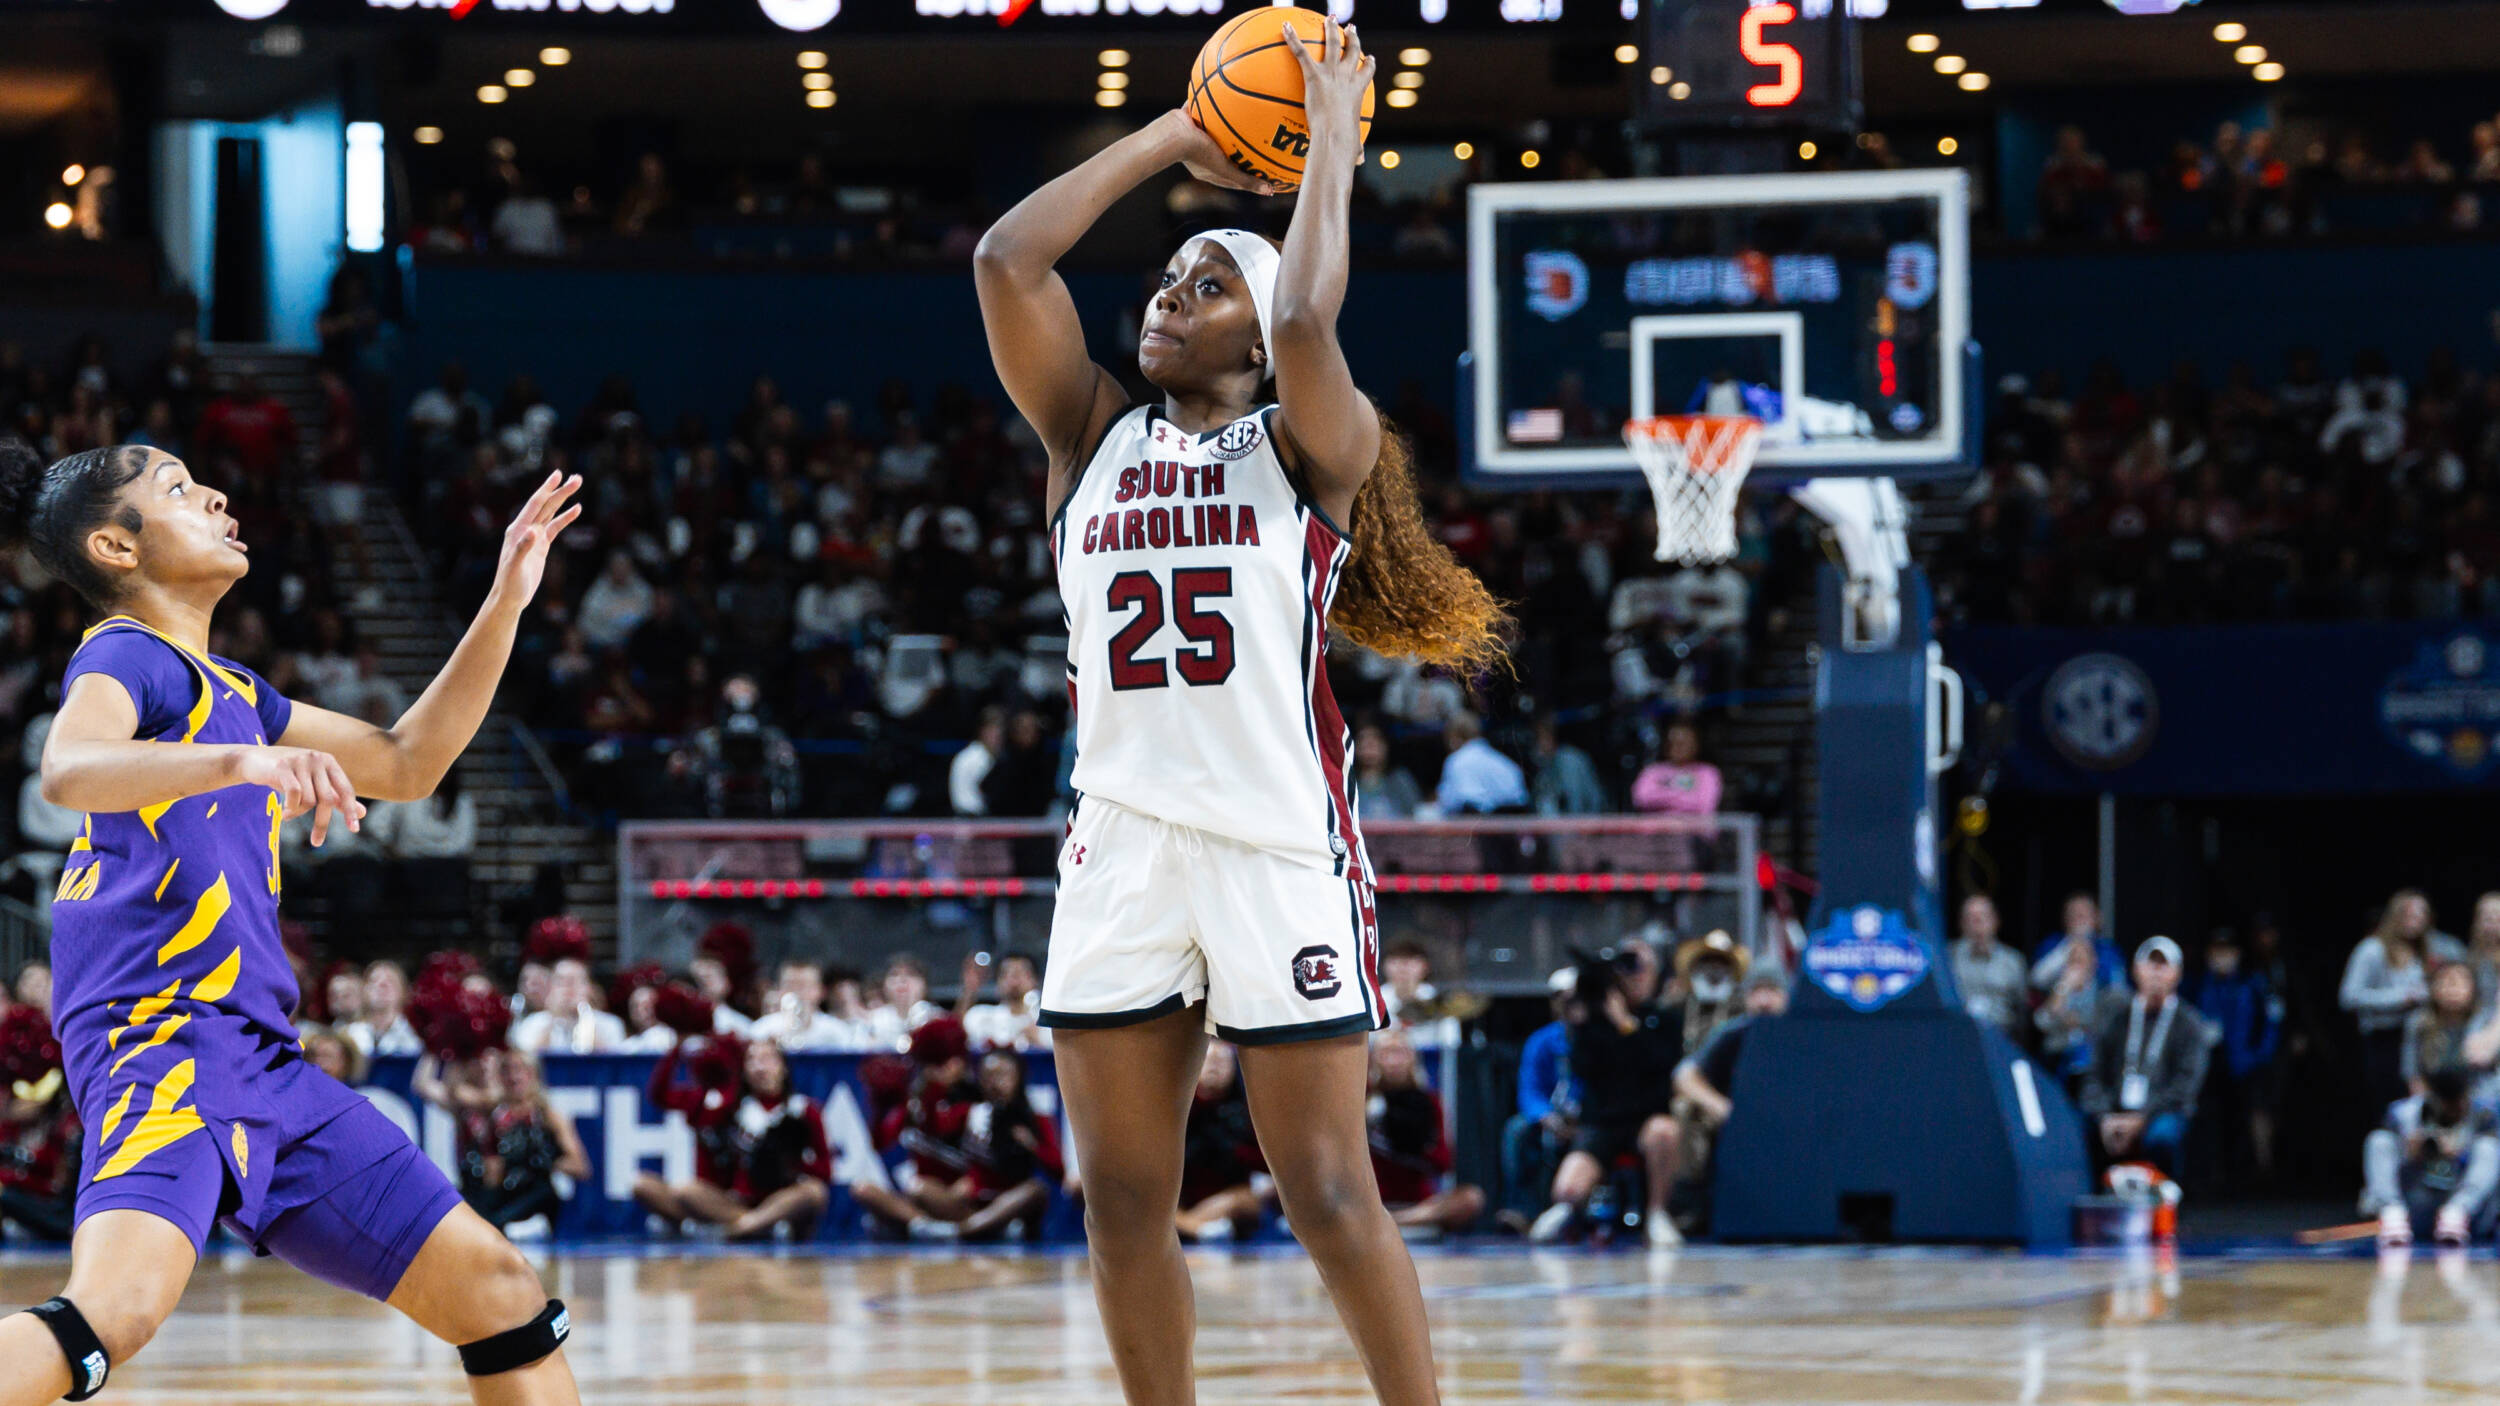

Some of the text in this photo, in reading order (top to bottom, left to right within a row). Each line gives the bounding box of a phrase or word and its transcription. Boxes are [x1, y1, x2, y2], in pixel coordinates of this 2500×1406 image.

[1739, 2, 1803, 107] 5
[1221, 422, 1254, 450] SEC
[1114, 459, 1225, 503] SOUTH
[1082, 504, 1261, 555] CAROLINA
[1106, 566, 1236, 691] 25
